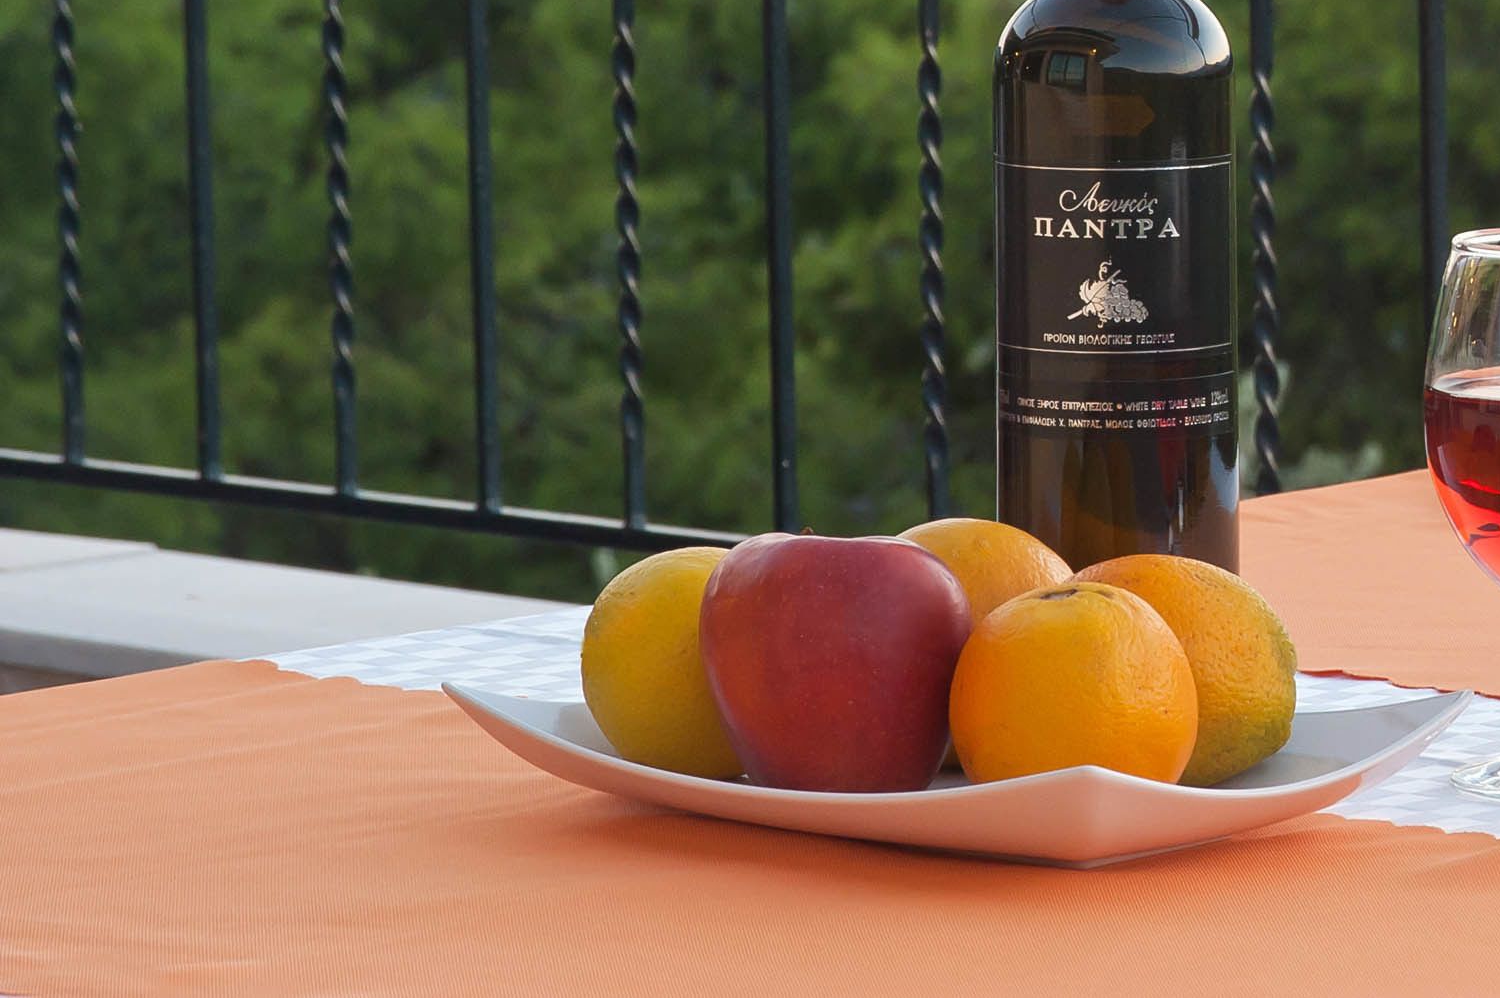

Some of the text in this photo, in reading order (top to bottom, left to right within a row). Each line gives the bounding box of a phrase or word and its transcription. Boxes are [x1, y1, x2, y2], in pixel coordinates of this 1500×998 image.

[1034, 217, 1180, 239] ΠΑΝΤΡΑ
[1037, 400, 1060, 410] ΞΗΡΟΣ
[1124, 401, 1149, 412] WHITE
[1151, 400, 1166, 411] DRY
